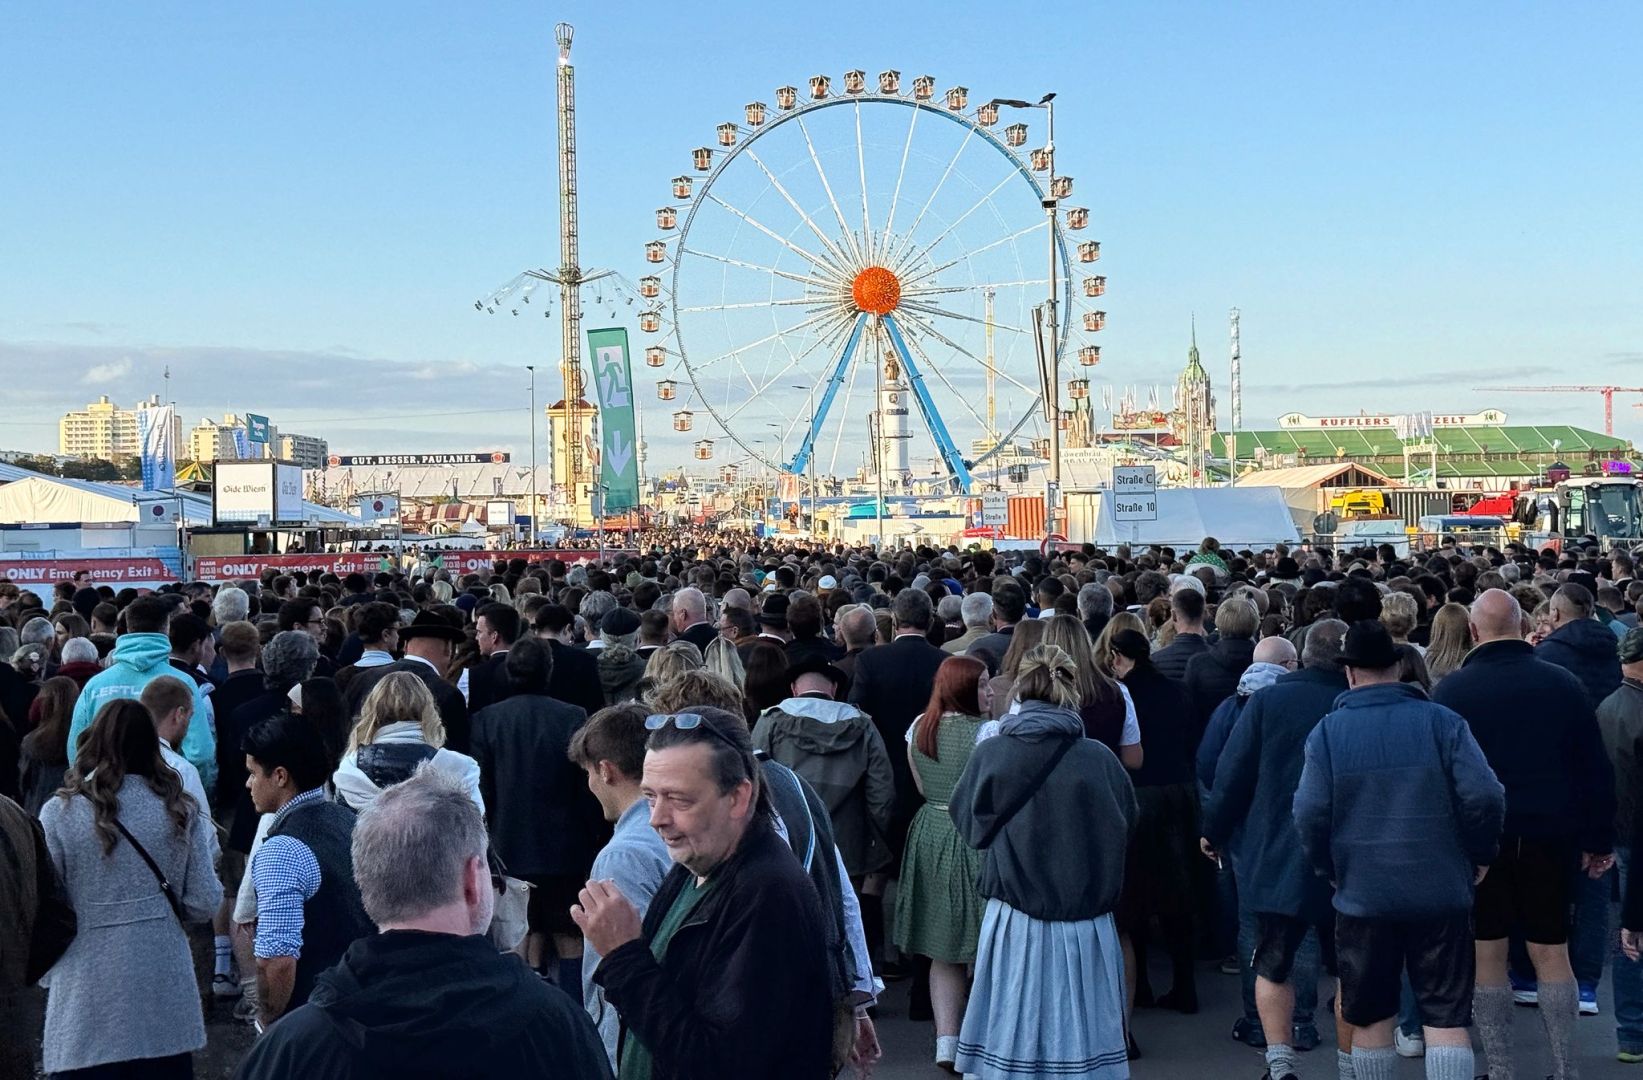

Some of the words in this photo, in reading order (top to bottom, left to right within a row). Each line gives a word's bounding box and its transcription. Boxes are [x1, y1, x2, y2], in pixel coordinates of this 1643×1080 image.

[1320, 417, 1390, 427] KUFFLERS
[351, 456, 376, 466] GUT,
[378, 455, 420, 465] BESSER,
[422, 454, 481, 464] PAULANER.
[1117, 474, 1144, 485] Straße
[1145, 473, 1153, 484] C
[1116, 502, 1143, 512] Straße
[1146, 502, 1155, 512] 10
[6, 568, 46, 580] ONLY
[49, 567, 124, 580] Emeency
[127, 565, 152, 578] Exit
[222, 563, 258, 576] ONLY
[333, 561, 355, 573] Exit
